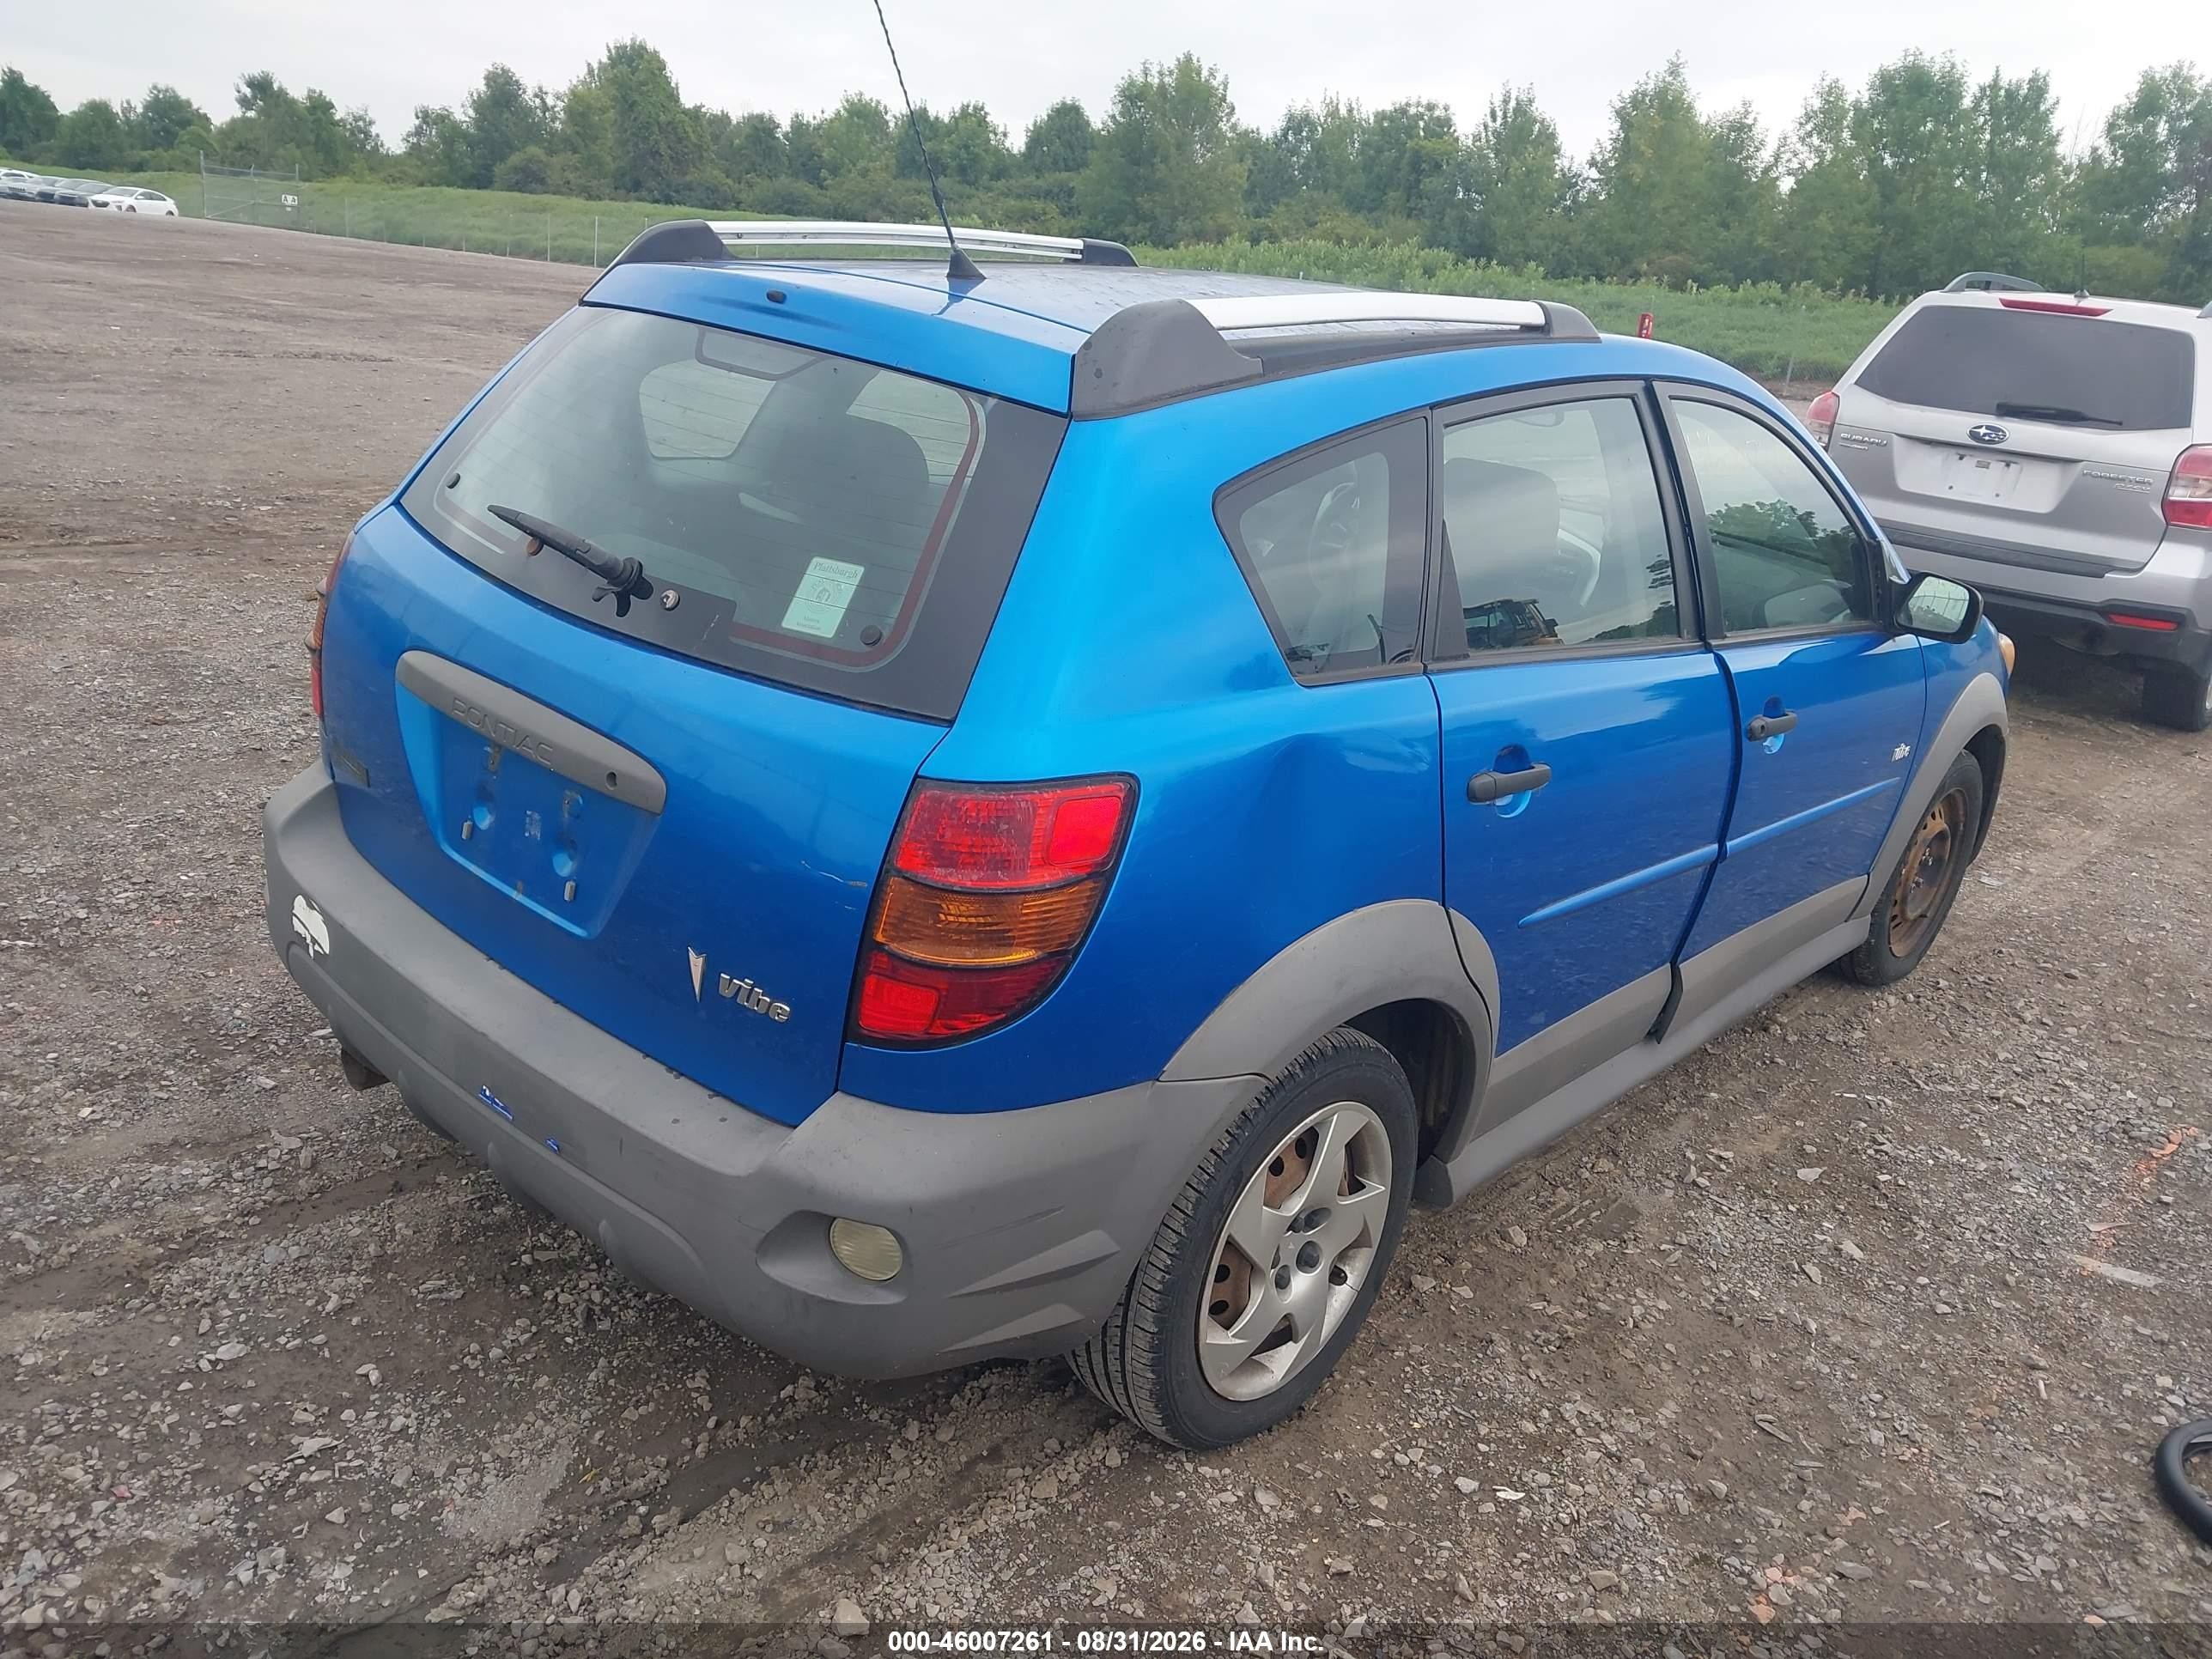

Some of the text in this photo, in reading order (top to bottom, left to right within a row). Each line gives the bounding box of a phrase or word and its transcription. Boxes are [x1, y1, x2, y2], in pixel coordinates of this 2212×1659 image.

[1840, 433, 1888, 447] SUBARU
[2082, 470, 2153, 485] FORESTER
[813, 562, 859, 580] Plattsburgh
[452, 696, 554, 766] PONTIAC
[719, 972, 790, 1023] vibe
